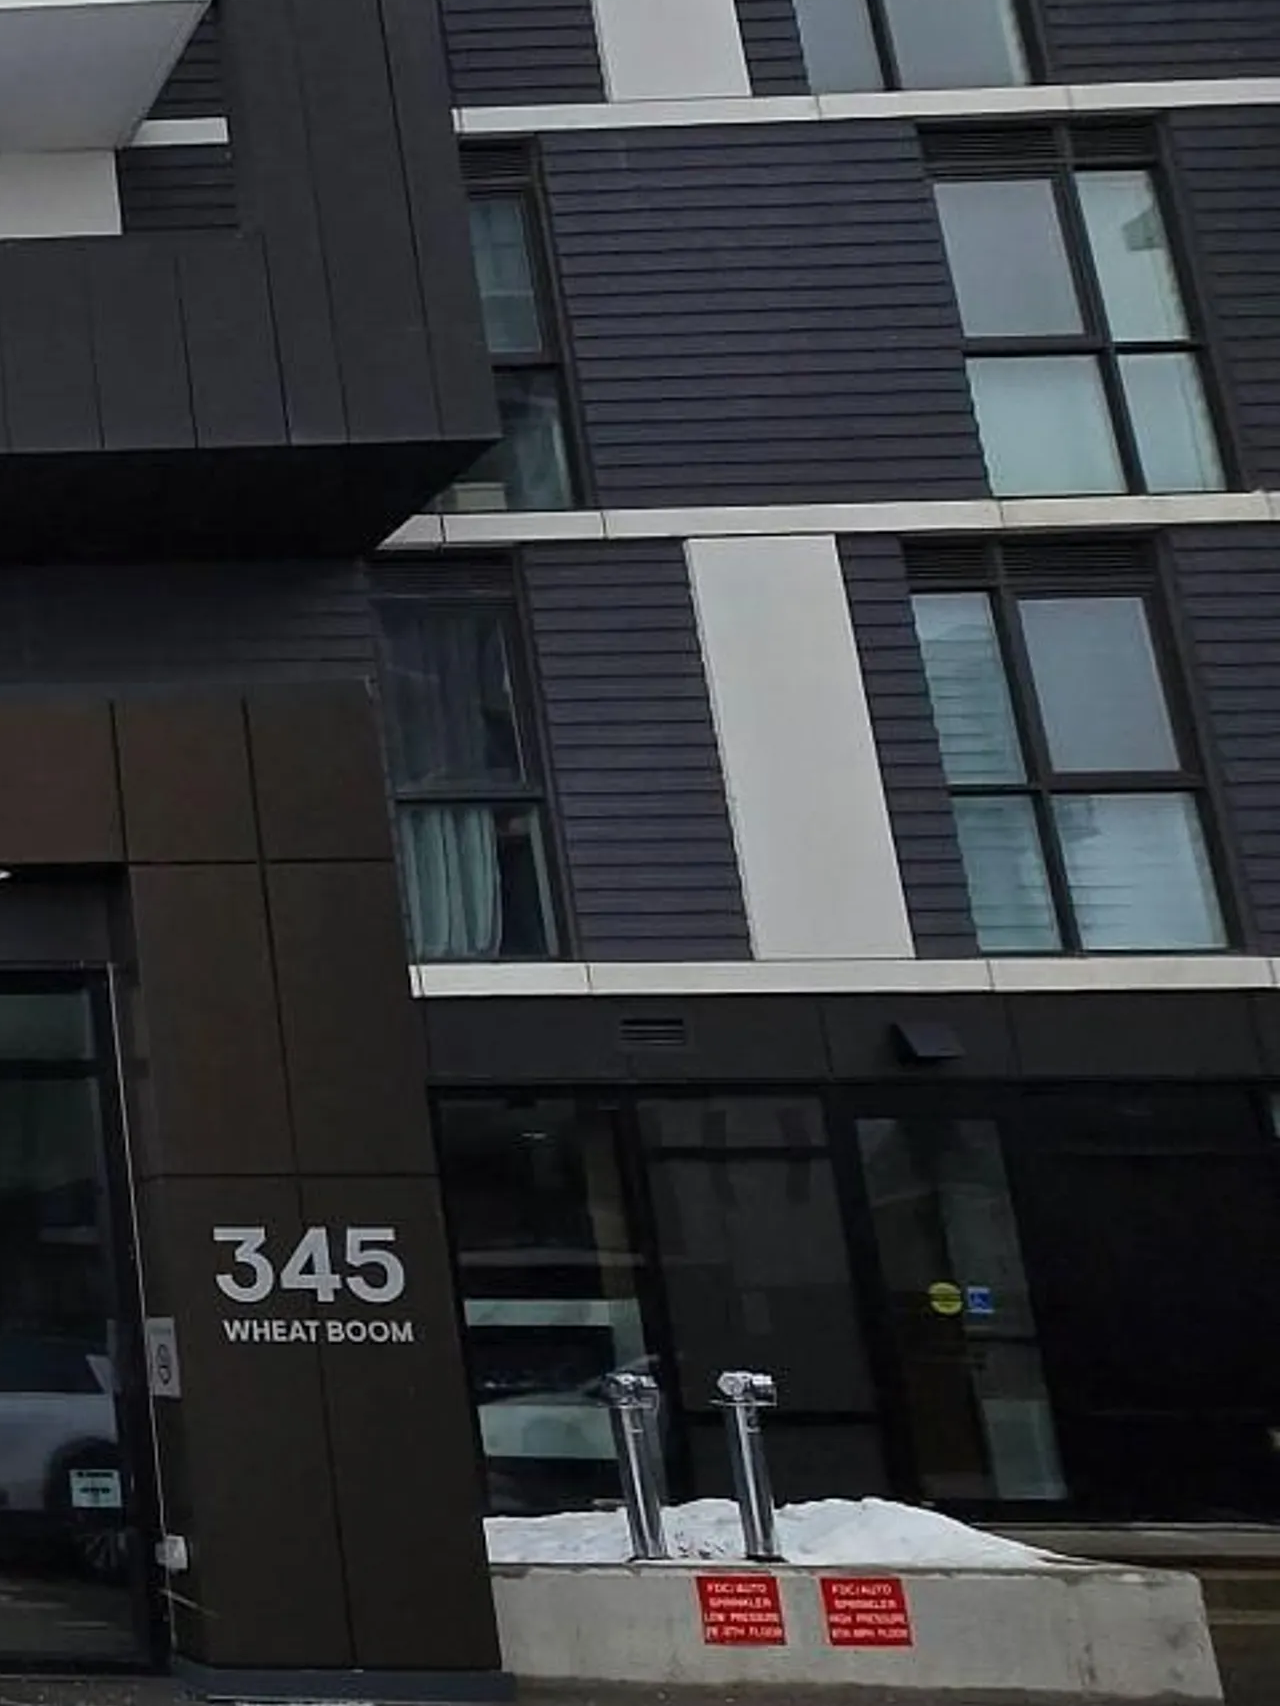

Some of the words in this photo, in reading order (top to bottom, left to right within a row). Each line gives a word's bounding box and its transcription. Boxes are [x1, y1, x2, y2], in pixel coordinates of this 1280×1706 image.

[212, 1225, 406, 1304] 345
[223, 1319, 321, 1342] WHEAT
[327, 1319, 415, 1343] BOOM
